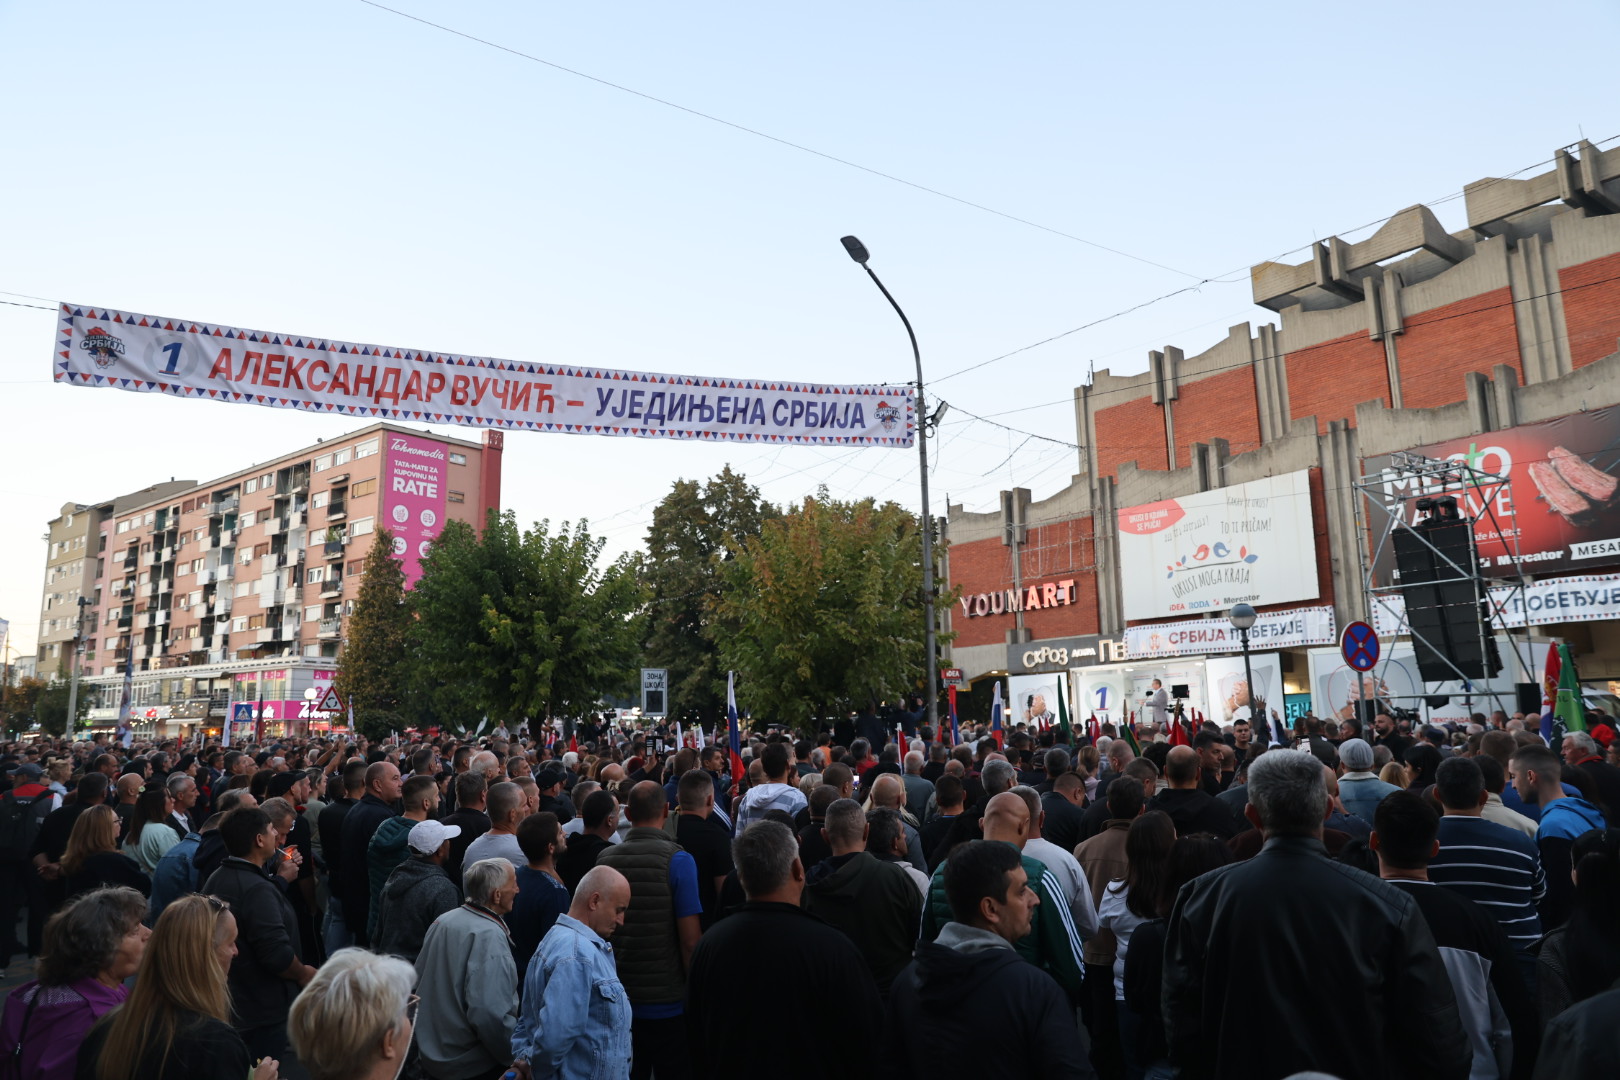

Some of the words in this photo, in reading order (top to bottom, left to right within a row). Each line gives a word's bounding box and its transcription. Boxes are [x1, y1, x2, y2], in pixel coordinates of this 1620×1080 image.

[80, 340, 126, 354] СРБИЈА
[161, 342, 183, 374] 1
[208, 347, 446, 406] АЛЕКСАНДАР
[451, 374, 555, 414] ВУЧИЋ
[595, 386, 767, 427] УЈЕДИЊЕНА
[772, 398, 867, 430] СРБИЈА
[390, 438, 445, 461] Tehnomedia
[393, 468, 427, 480] KUPOVINU
[428, 474, 438, 482] NA
[394, 459, 429, 472] TATA-MATE
[429, 466, 439, 474] ZA
[392, 476, 438, 499] RATE
[1220, 521, 1229, 534] TO
[1231, 520, 1239, 533] TI
[1240, 517, 1272, 533] PRIČAM!
[1172, 575, 1198, 599] UKUSI
[1198, 568, 1223, 589] MOGA
[1224, 567, 1250, 585] KRAJA
[960, 579, 1075, 618] YOUMART
[1189, 600, 1210, 610] RODA
[1223, 594, 1260, 605] Mercator
[1168, 628, 1226, 645] СРБИЈА
[646, 672, 663, 680] ЗОНА
[644, 681, 665, 689] ШКОЛЕ
[1095, 686, 1109, 709] 1
